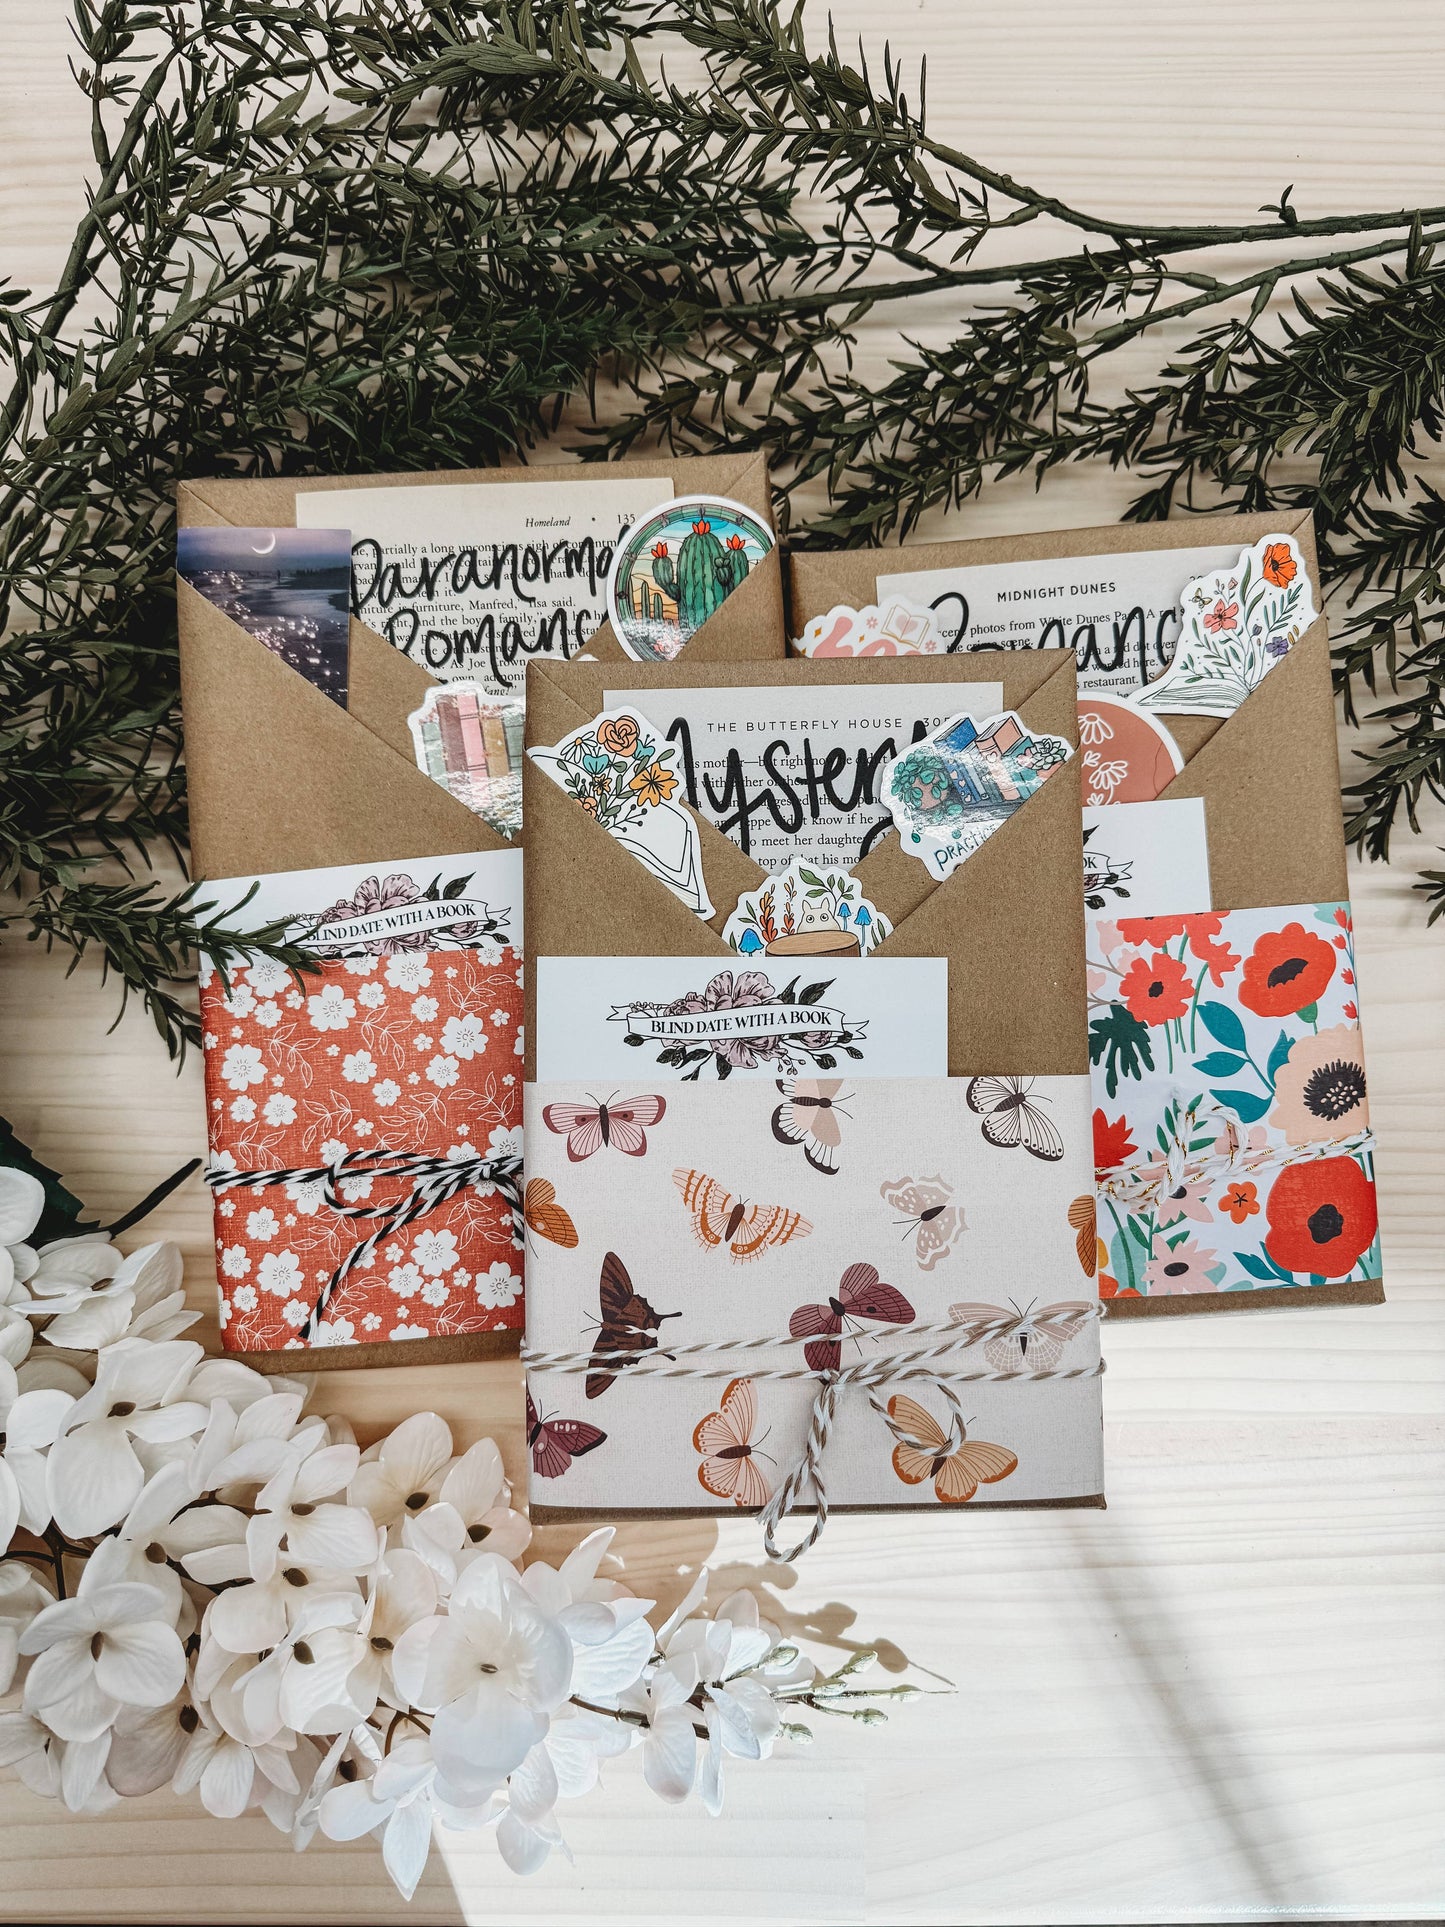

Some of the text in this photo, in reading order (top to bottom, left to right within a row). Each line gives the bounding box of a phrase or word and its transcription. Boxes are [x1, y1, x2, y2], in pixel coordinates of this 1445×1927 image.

[525, 513, 636, 528] Homeland 135
[421, 545, 428, 554] a
[431, 542, 454, 557] long
[458, 541, 524, 552] unconscis
[350, 524, 631, 621] Paranorma
[353, 562, 378, 570] rvan
[997, 582, 1116, 602] MIDNIGHT DUNES
[359, 604, 394, 614] niture
[411, 601, 464, 613] furniture,
[551, 597, 576, 607] said.
[380, 617, 412, 630] rght,
[418, 616, 436, 626] nd
[440, 615, 458, 626] the
[499, 612, 542, 626] family,”
[970, 624, 1006, 637] photos
[1009, 620, 1035, 631] from
[1076, 613, 1111, 625] Dunes
[1146, 609, 1155, 619] A
[1159, 607, 1177, 618] rd
[396, 635, 412, 643] wa
[1000, 637, 1034, 649] scene.
[383, 607, 609, 687] Romanc
[420, 645, 438, 656] te
[1104, 646, 1111, 655] a
[1133, 641, 1150, 654] dt
[450, 659, 464, 669] As
[467, 658, 486, 671] Joe
[495, 657, 526, 667] rown
[1092, 659, 1131, 672] wored
[1132, 659, 1159, 669] hre.
[483, 670, 526, 682] adoni
[1083, 677, 1139, 688] restaurant.
[707, 722, 737, 733] THE
[746, 719, 840, 732] BUTTERFLY
[848, 718, 903, 729] HOUSE
[780, 754, 806, 770] righ
[738, 815, 771, 830] eppe
[812, 814, 842, 826] know
[846, 812, 859, 825] if
[860, 812, 874, 824] he
[761, 836, 789, 847] meet
[794, 834, 813, 846] her
[817, 833, 877, 848] daughte?
[757, 853, 862, 870] top of hat his mo
[350, 919, 383, 938] DATE
[385, 911, 421, 929] WITH
[423, 908, 435, 920] A
[437, 903, 477, 919] BOOK
[651, 1010, 832, 1035] BLIND DATE WITH A BOOK
